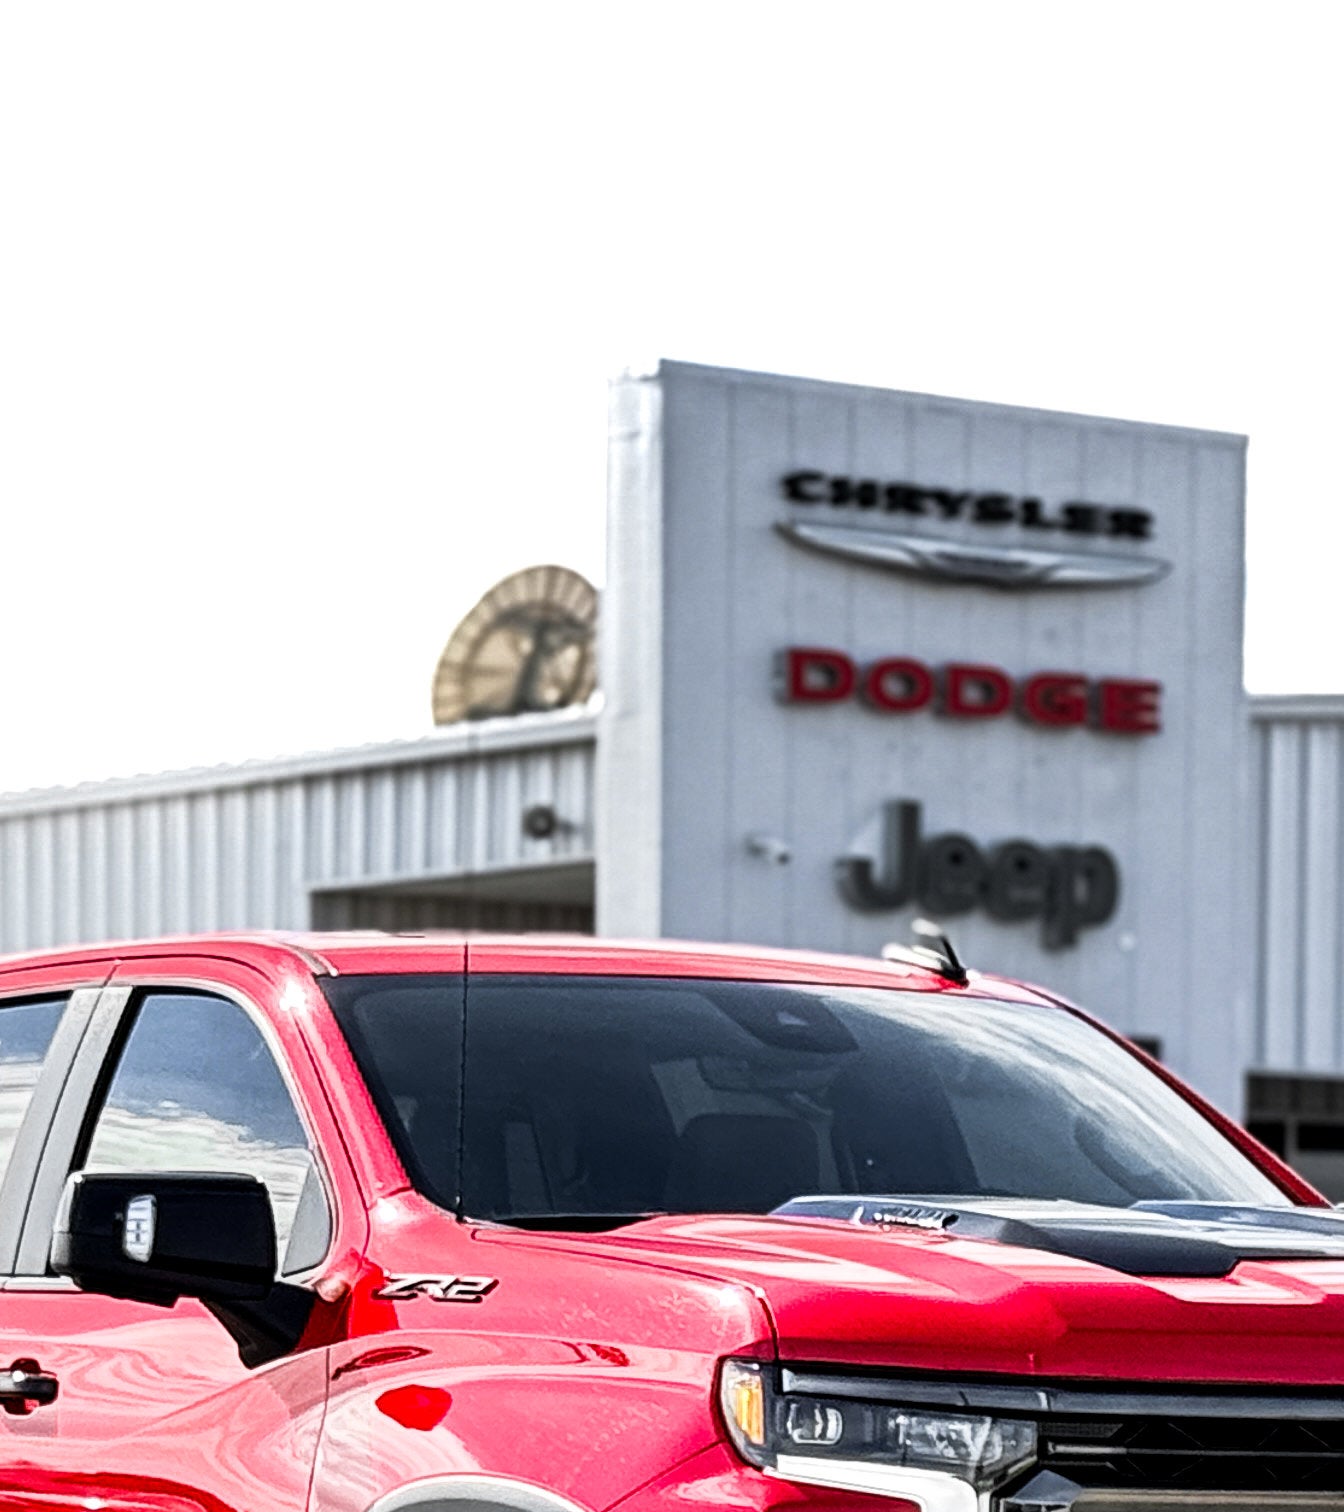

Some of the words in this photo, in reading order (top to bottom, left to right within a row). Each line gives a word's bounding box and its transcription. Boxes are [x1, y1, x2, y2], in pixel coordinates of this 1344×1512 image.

[780, 470, 1154, 541] CHRYSLER
[778, 645, 1163, 738] DODGE
[836, 798, 1120, 954] Jeep
